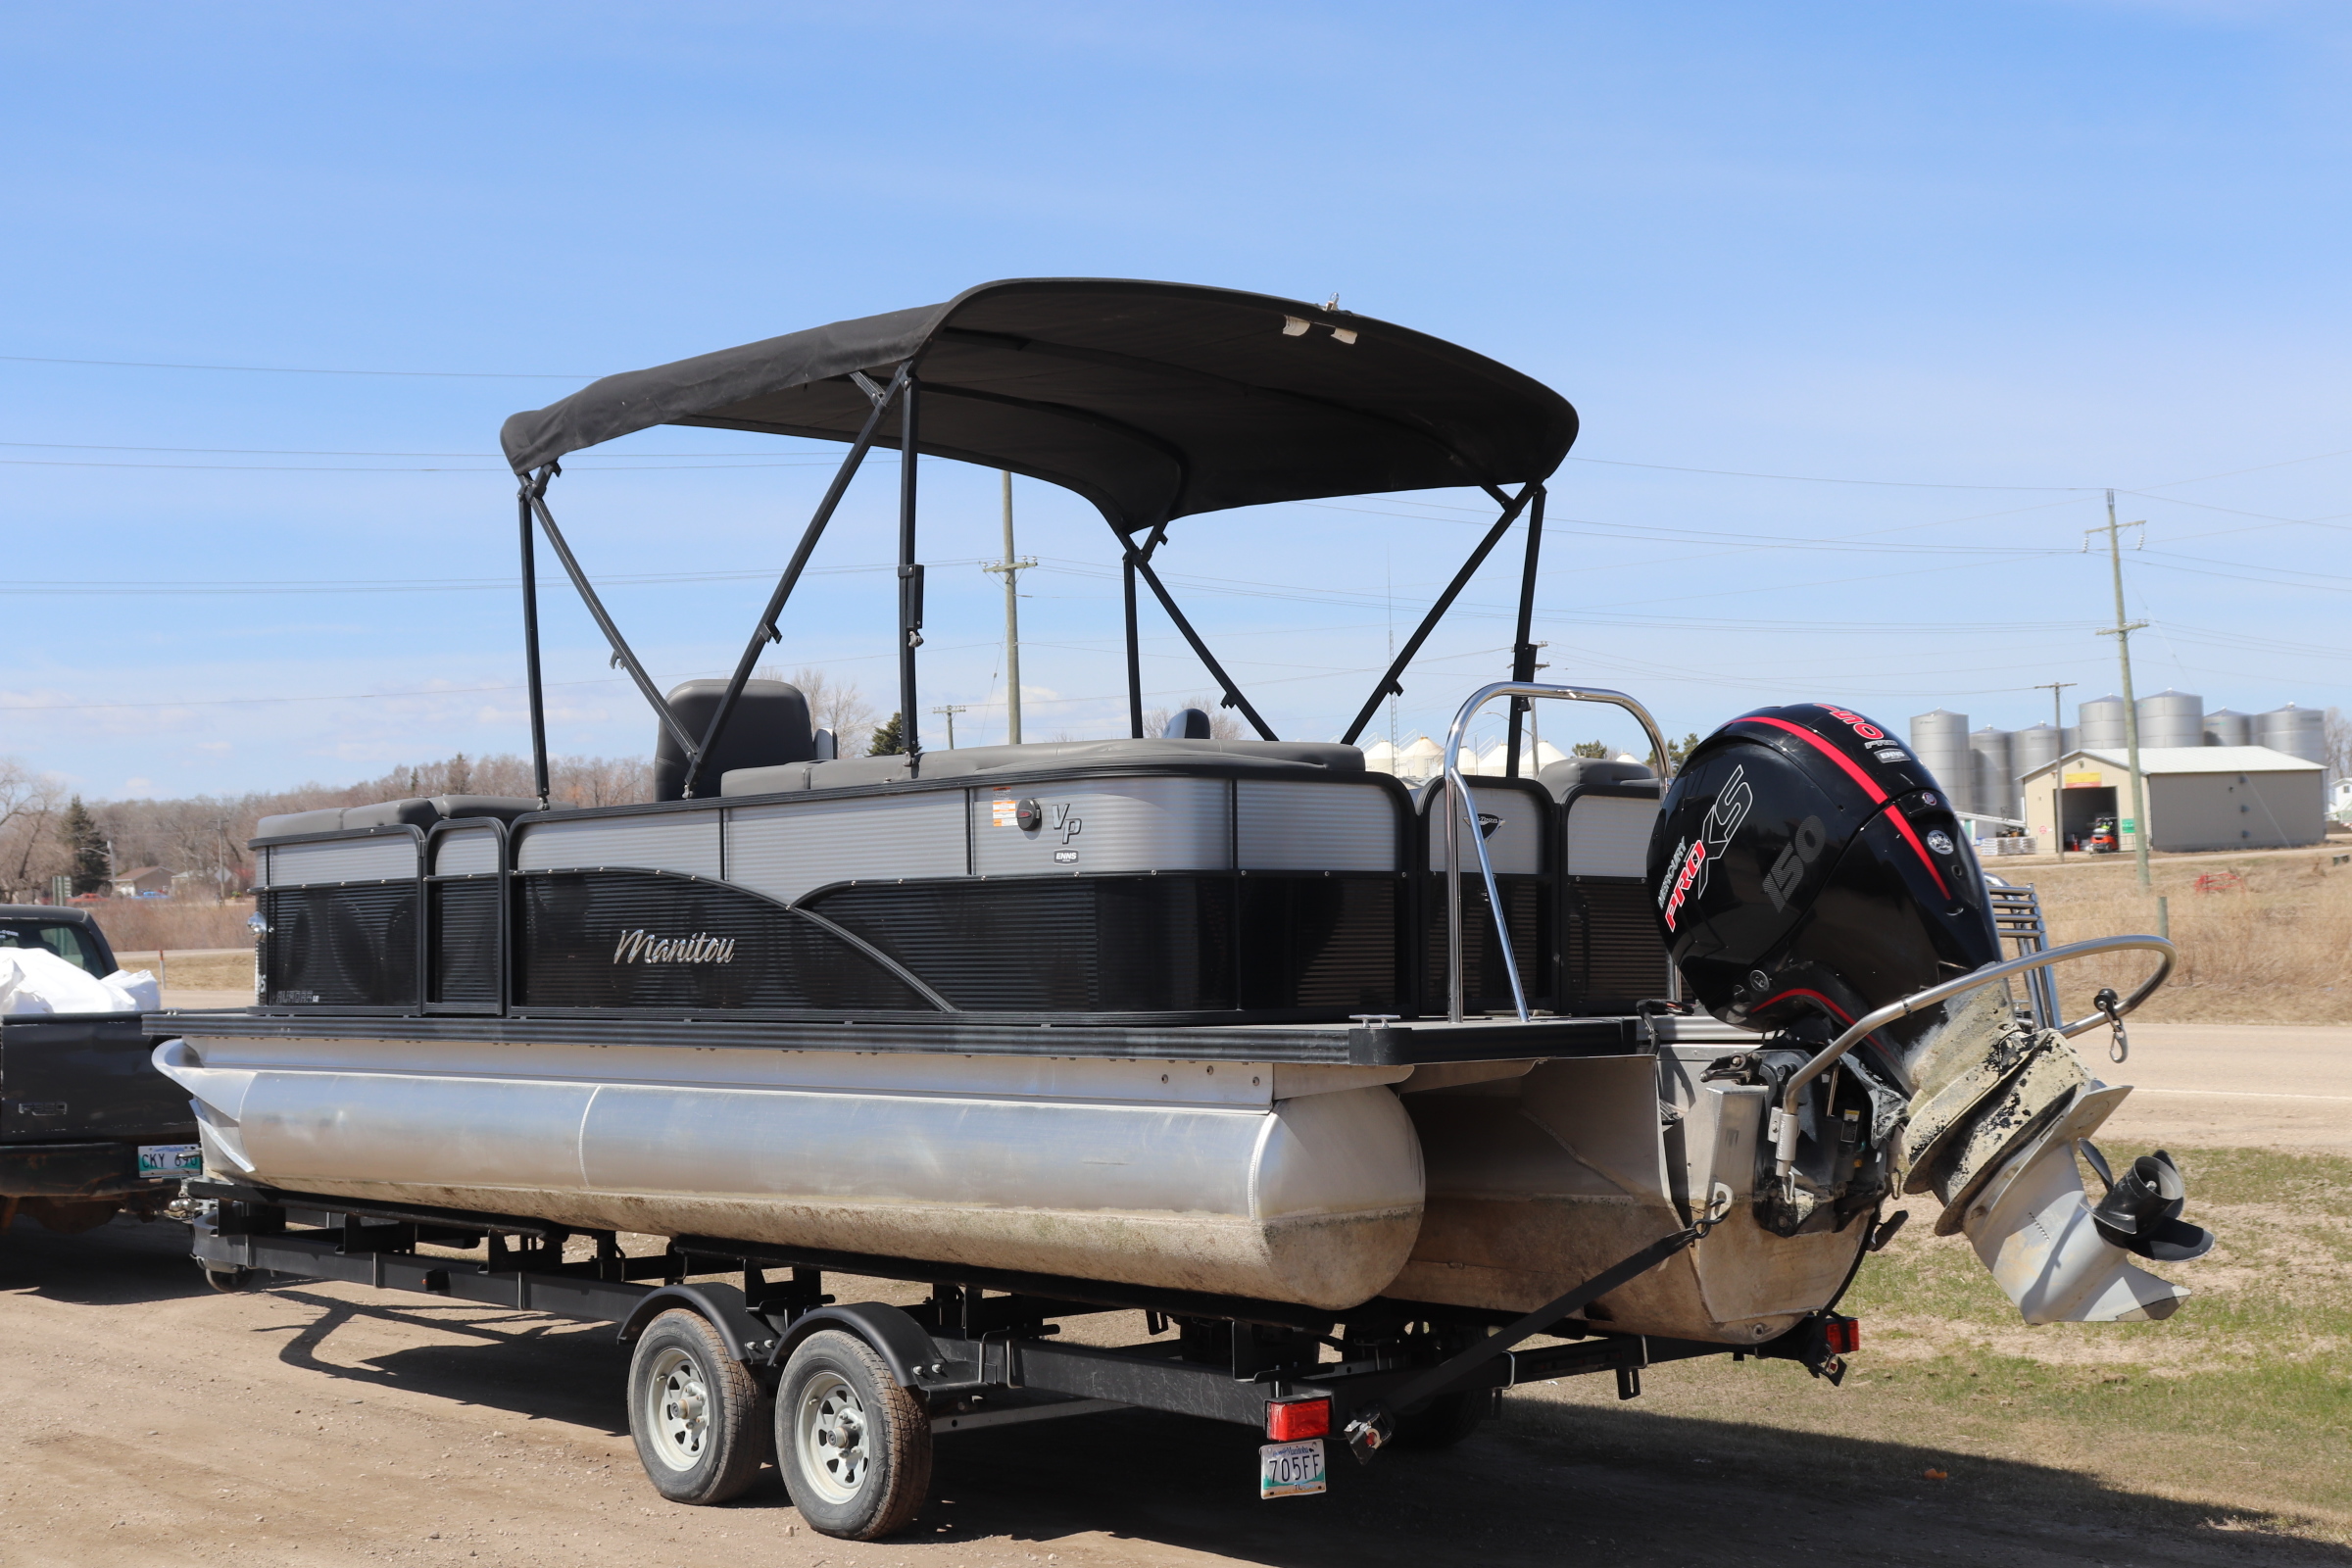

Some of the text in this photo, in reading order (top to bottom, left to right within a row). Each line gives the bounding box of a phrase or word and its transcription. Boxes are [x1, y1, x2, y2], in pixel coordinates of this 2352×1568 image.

[1812, 703, 1885, 740] 150
[1055, 852, 1077, 860] ENNS
[1665, 763, 1753, 933] PRO XS
[1761, 814, 1827, 913] 150
[1657, 835, 1687, 910] MERCURY
[613, 928, 735, 964] Manitou
[142, 1152, 165, 1168] CKY
[1268, 1453, 1320, 1484] 705FF
